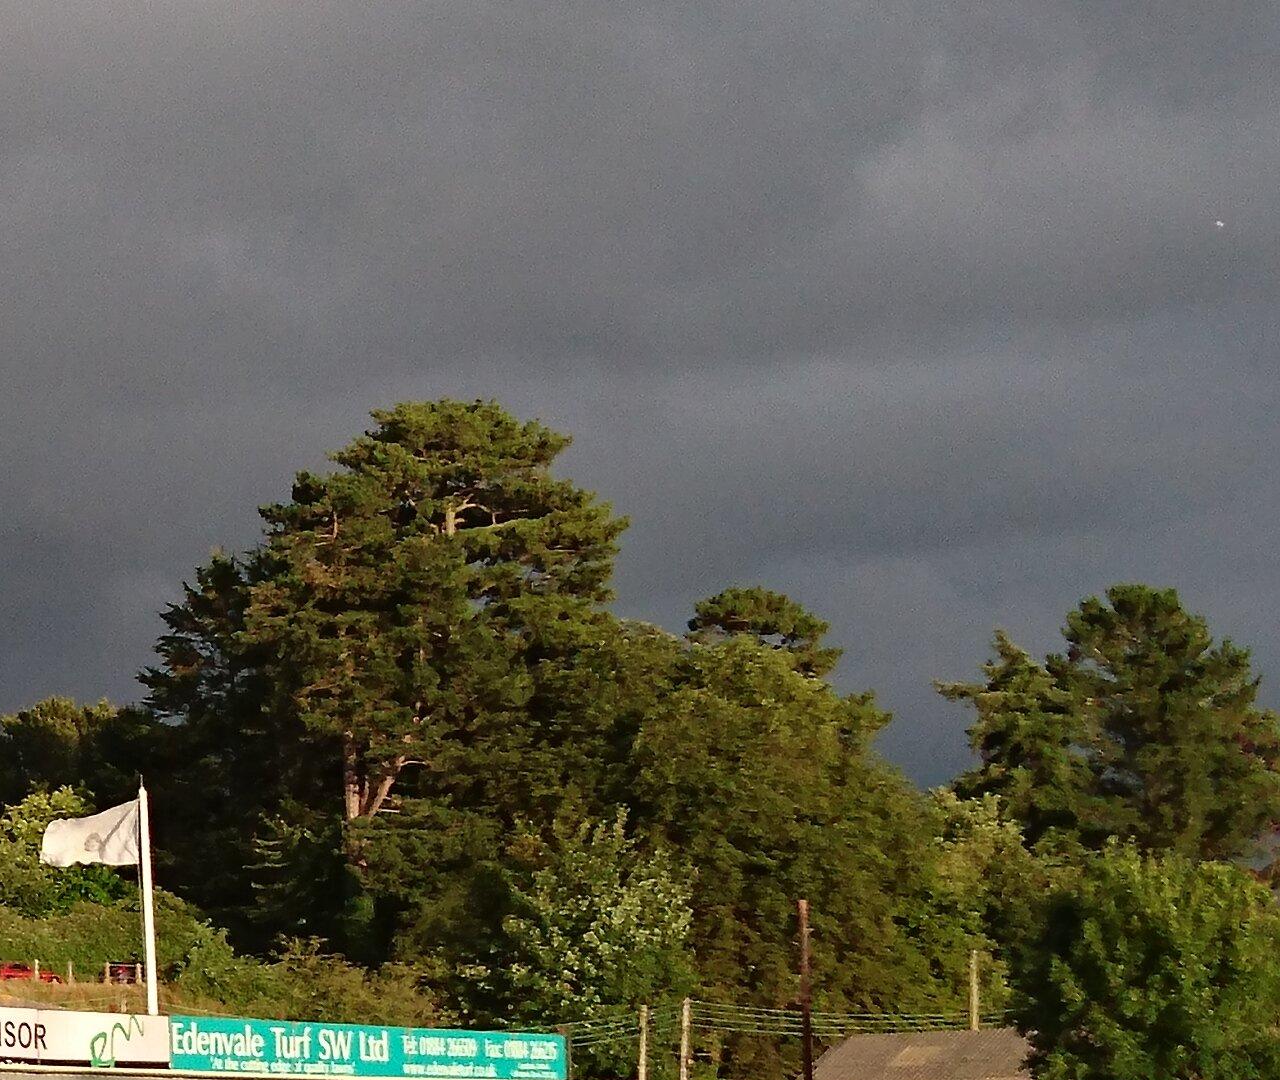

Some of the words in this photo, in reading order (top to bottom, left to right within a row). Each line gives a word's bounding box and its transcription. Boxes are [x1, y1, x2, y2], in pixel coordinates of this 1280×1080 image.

[172, 1022, 265, 1057] Edenvale
[270, 1026, 312, 1059] Turf
[318, 1029, 352, 1061] SW
[359, 1030, 388, 1062] Ltd
